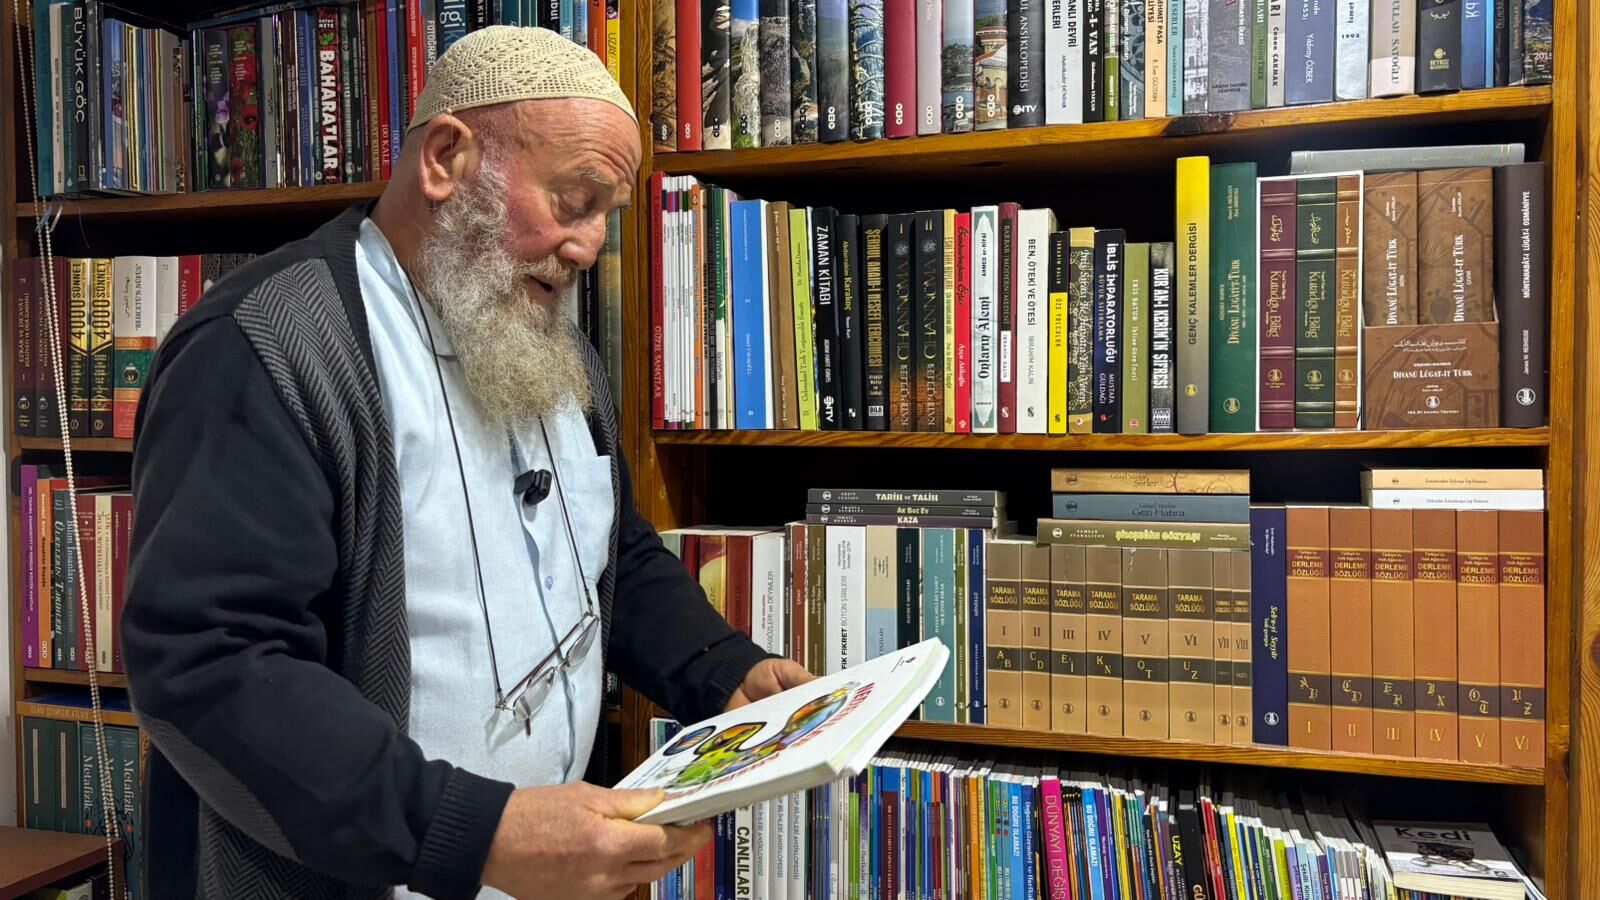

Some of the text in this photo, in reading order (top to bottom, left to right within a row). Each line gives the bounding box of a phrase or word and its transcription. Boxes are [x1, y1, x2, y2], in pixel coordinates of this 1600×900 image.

[1170, 3, 1178, 37] ESERLER
[607, 32, 617, 57] UZAY
[1068, 21, 1079, 48] DEVRİ
[1089, 30, 1098, 56] VAN
[1155, 25, 1164, 45] PAŞA
[74, 6, 87, 123] BÜYÜK GÖÇ
[1019, 15, 1030, 92] ANSİKLOPEDİSİ
[1270, 26, 1280, 87] Canan ÇAKMAK
[1304, 33, 1315, 84] Yıldıray ÖZBEK
[320, 50, 338, 169] BAHARATLAR
[1021, 105, 1037, 113] NTV
[392, 129, 400, 143] 100
[382, 139, 390, 165] KALE
[1001, 224, 1010, 254] BARBAR
[1386, 238, 1398, 261] TÜRK
[1453, 234, 1465, 257] TÜRK
[815, 225, 833, 306] ZAMAN KİTABI
[944, 267, 954, 290] BOYLARI
[1026, 238, 1038, 326] BEN, ÖTEKİ VE ÖTESİ
[1186, 221, 1198, 345] GENÇ KALEMLER DERGİSİ
[69, 262, 86, 340] 4000 SÜNNET
[91, 262, 110, 340] 4000 SÜNNET
[843, 276, 853, 311] Karakoç
[864, 228, 884, 367] ŞERHUL AKAİD-İ NESEFİ TERCÜMESİ
[1105, 243, 1120, 363] İBLİS İMPARATORLUĞU
[1267, 270, 1281, 338] Kutadgu Bilig
[1305, 271, 1320, 338] Kutadgu Bilig
[1337, 269, 1352, 338] Kutadgu Bilig
[896, 262, 909, 361] CİHANNÜMA
[923, 259, 937, 360] CİHANNÜMA
[1074, 271, 1090, 355] Sırası Hayata
[1131, 297, 1139, 321] BATUR
[1055, 297, 1063, 347] ÖZE YOLCULUK
[1153, 267, 1173, 389] KUR'AN-I KERİM'İN ŞİFRESİ
[652, 325, 663, 352] GÜZEL
[823, 338, 831, 355] ADAM
[975, 295, 994, 380] Onların Âlemi
[1027, 335, 1036, 385] İBRAHİM KALIN
[1131, 347, 1139, 362] Göre
[653, 353, 664, 399] SANATLAR
[798, 354, 810, 402] Geleneksel Türk
[958, 360, 966, 387] Atikoğlu
[1393, 368, 1473, 379] DİVANÜ TÜRK
[1099, 373, 1107, 404] GÜLDAĞI
[824, 402, 834, 422] NTV
[875, 491, 903, 501] TARİH
[912, 492, 938, 502] TALİH
[66, 519, 77, 584] Bilim İnsanları
[1292, 561, 1325, 569] DERLEME
[1292, 569, 1325, 578] SÖZLÜĞÜ
[1334, 561, 1367, 570] DERLEME
[1334, 569, 1367, 578] SÖZLÜĞÜ
[1375, 563, 1409, 571] DERLEME
[1375, 571, 1409, 580] SÖZLÜĞÜ
[1417, 562, 1452, 571] DERLEME
[1417, 570, 1452, 579] SÖZLÜĞÜ
[1460, 566, 1496, 574] DERLEME
[1502, 566, 1539, 575] DERLEME
[54, 520, 66, 635] ÜLKELERİN TARİHLERİ
[1460, 574, 1496, 583] SÖZLÜĞÜ
[1502, 574, 1539, 583] SÖZLÜĞÜ
[989, 596, 1018, 605] SÖZLÜĞÜ
[991, 587, 1016, 595] TARAMA
[1022, 596, 1049, 606] SÖZLÜĞÜ
[1024, 587, 1049, 595] TARAMA
[1054, 598, 1083, 608] SÖZLÜĞÜ
[1055, 589, 1082, 598] TARAMA
[1090, 590, 1117, 599] TARAMA
[1131, 592, 1159, 601] TARAMA
[1176, 593, 1203, 603] TARAMA
[841, 603, 850, 627] BÜTÜN
[1089, 599, 1118, 610] SÖZLÜĞÜ
[1129, 602, 1160, 612] SÖZLÜĞÜ
[1174, 602, 1205, 613] SÖZLÜĞÜ
[1032, 626, 1041, 637] II
[1062, 629, 1075, 640] III
[1098, 629, 1110, 641] IV
[1184, 634, 1198, 646] VI
[1218, 638, 1230, 649] VII
[1235, 639, 1249, 650] VIII
[1347, 723, 1357, 737] II
[1386, 726, 1400, 741] III
[1429, 727, 1446, 742] IV
[1514, 735, 1529, 750] VI
[82, 754, 94, 810] Metafizik
[123, 759, 135, 815] Metafizik
[1010, 795, 1020, 857] BU DOĞRU OLAMAZ!
[1024, 801, 1034, 864] Doğanın Gizemleri
[1044, 795, 1061, 854] DÜNYAYI
[1085, 804, 1097, 867] BU DOĞRU OLAMAZ!
[1394, 827, 1473, 842] Kedi
[736, 826, 750, 896] CANLILAR
[776, 834, 784, 879] ANSİKLOPEDİSİ
[792, 836, 801, 881] ANSİKLOPEDİSİ
[1171, 835, 1183, 867] UZAY
[1300, 862, 1309, 884] Şekilli
